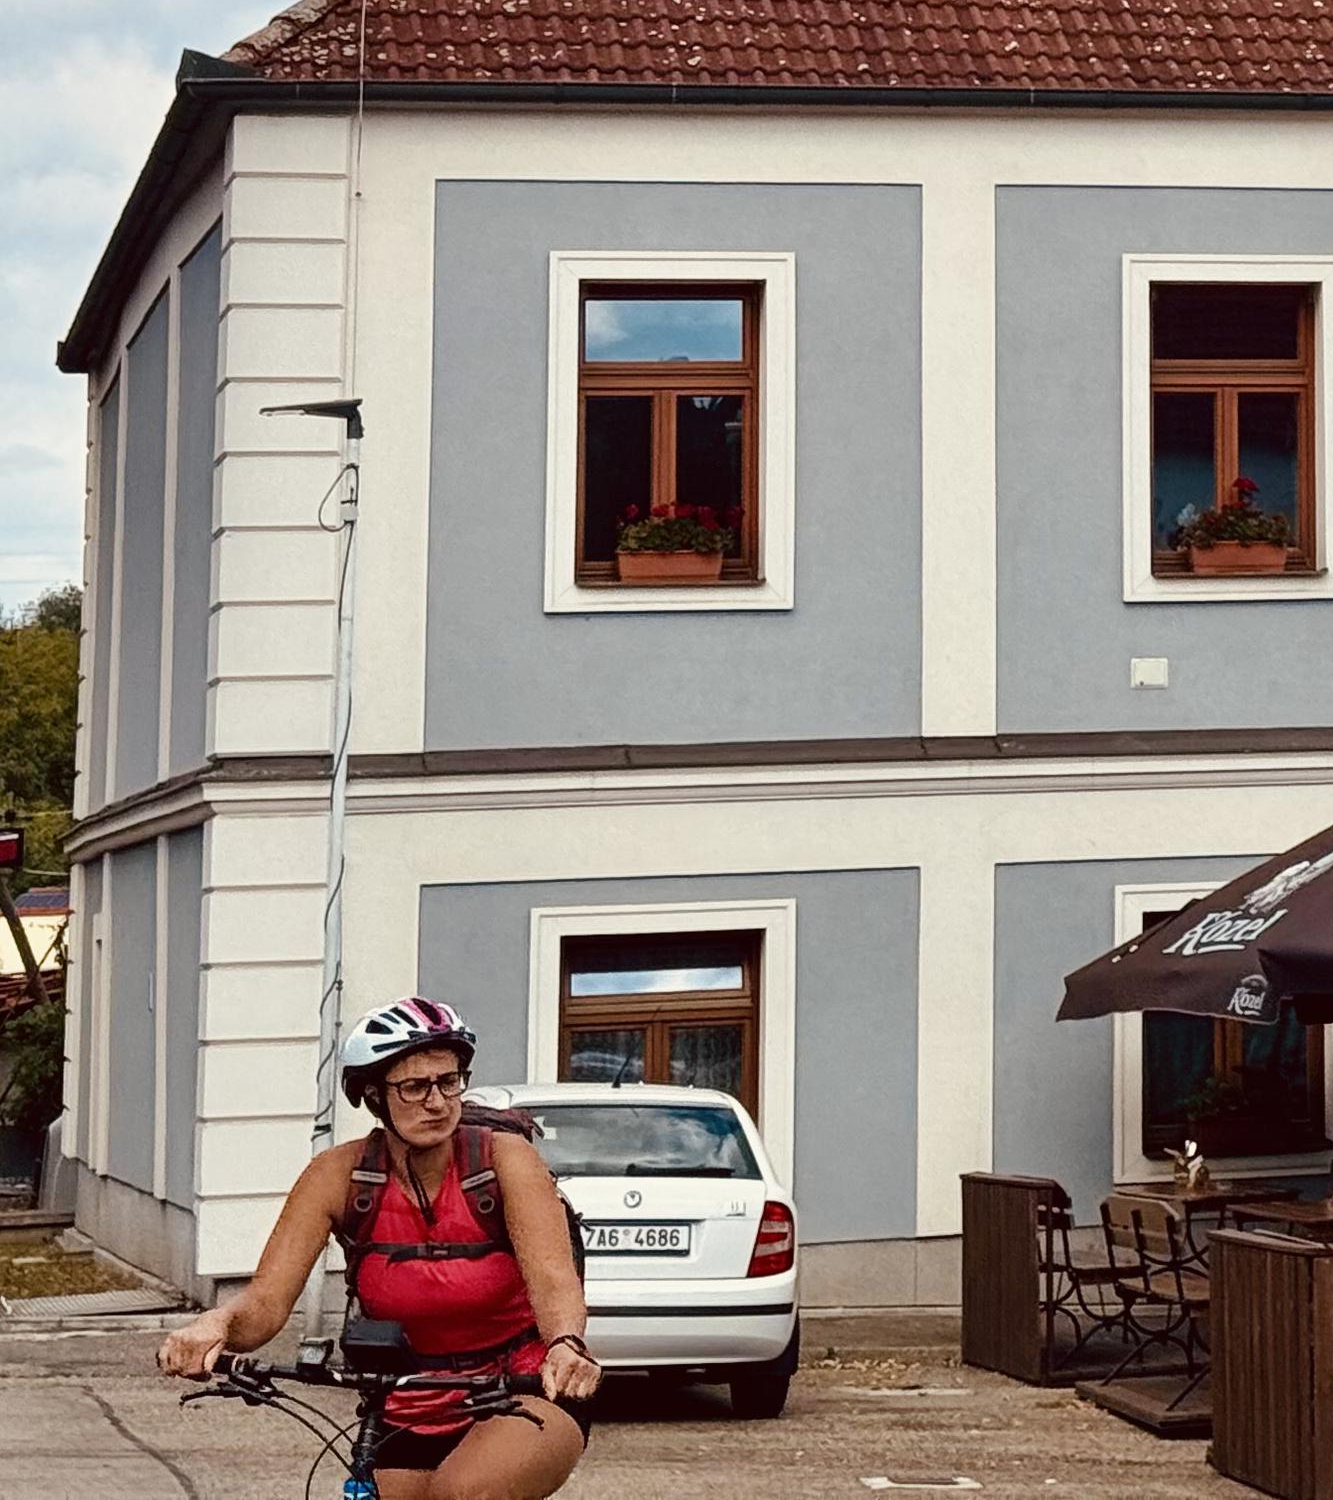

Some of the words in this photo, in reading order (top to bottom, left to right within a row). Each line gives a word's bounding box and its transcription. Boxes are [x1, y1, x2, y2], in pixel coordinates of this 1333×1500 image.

[1162, 908, 1288, 956] Kozel
[585, 1228, 619, 1247] 7A6
[634, 1228, 680, 1247] 4686
